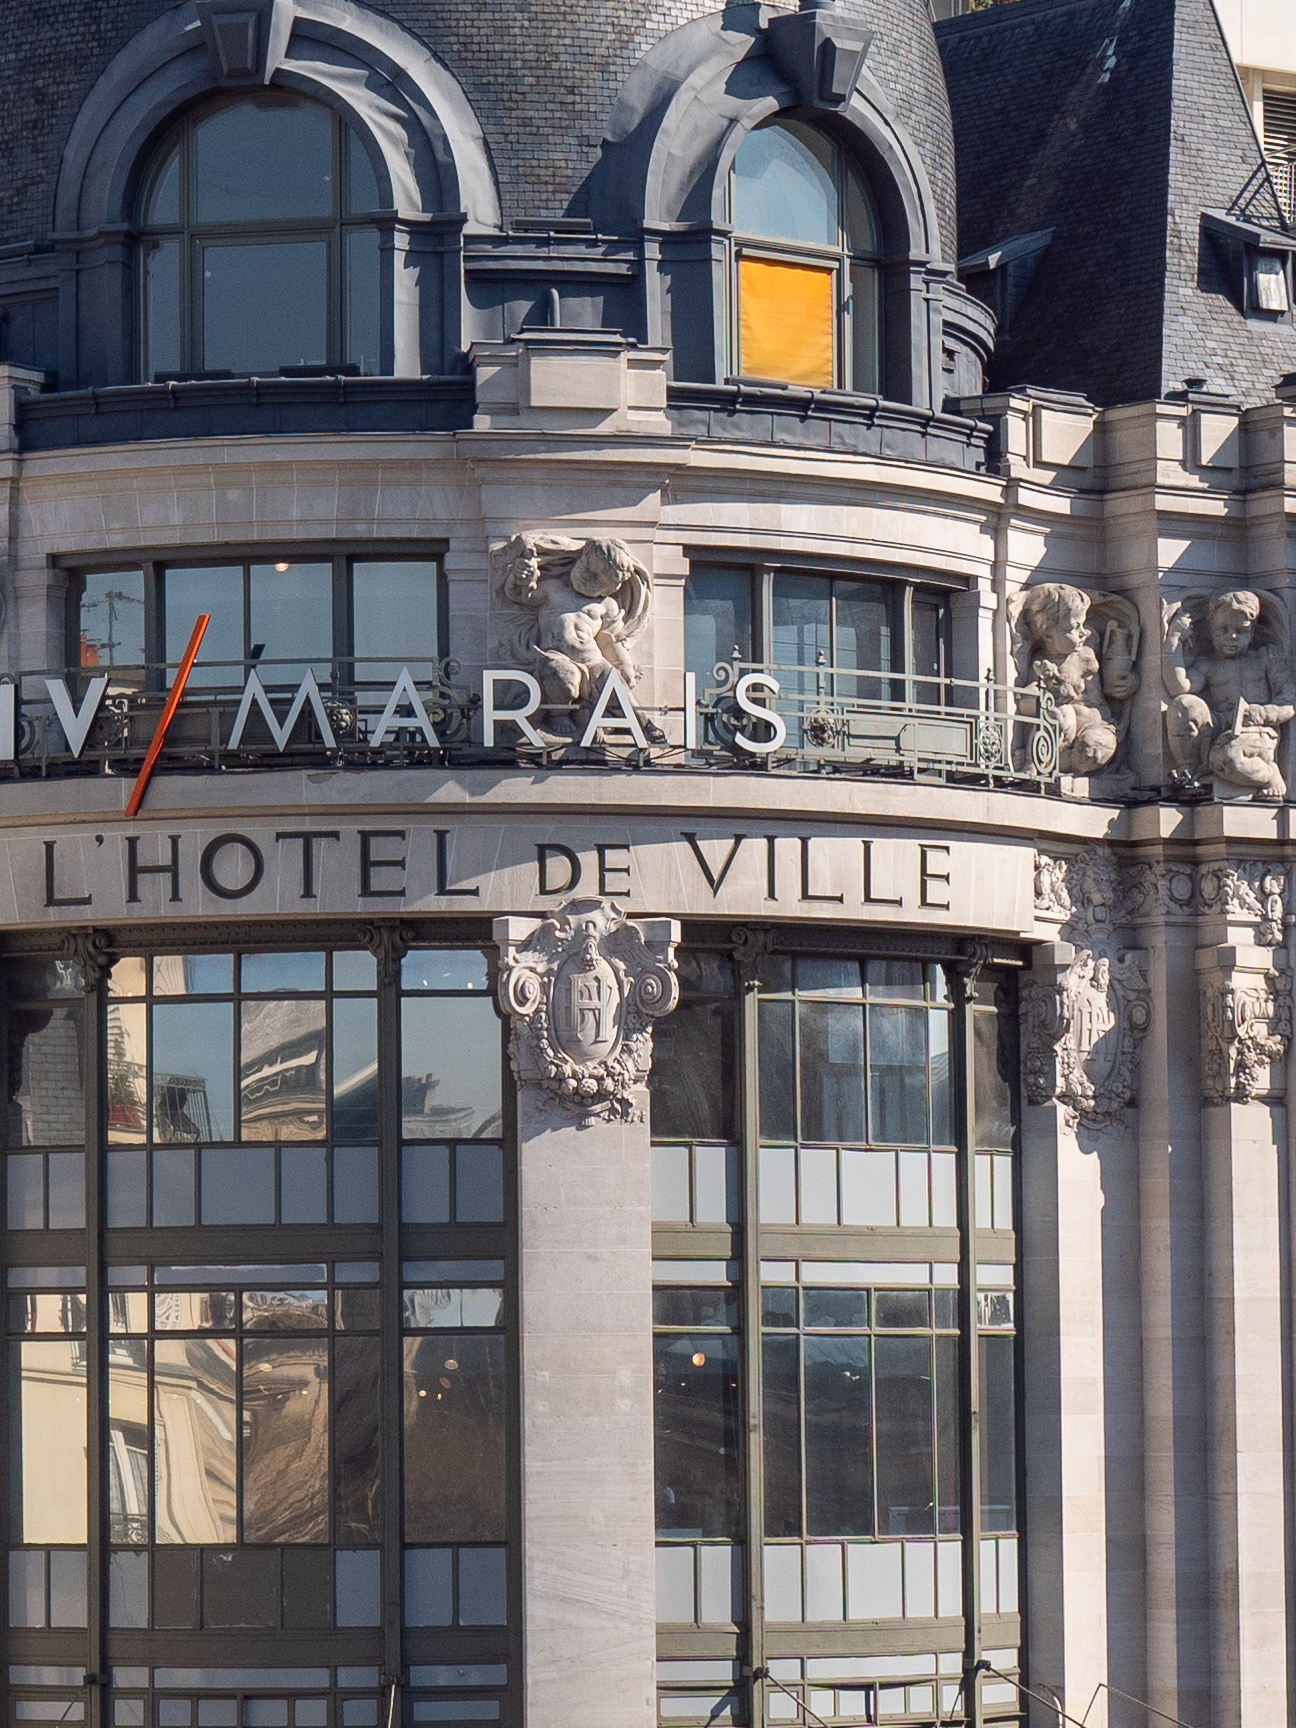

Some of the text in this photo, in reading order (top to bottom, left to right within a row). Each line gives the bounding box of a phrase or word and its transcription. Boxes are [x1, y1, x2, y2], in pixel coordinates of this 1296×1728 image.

[227, 666, 786, 754] MARAIS
[535, 842, 632, 898] DE
[681, 832, 953, 910] VILLE
